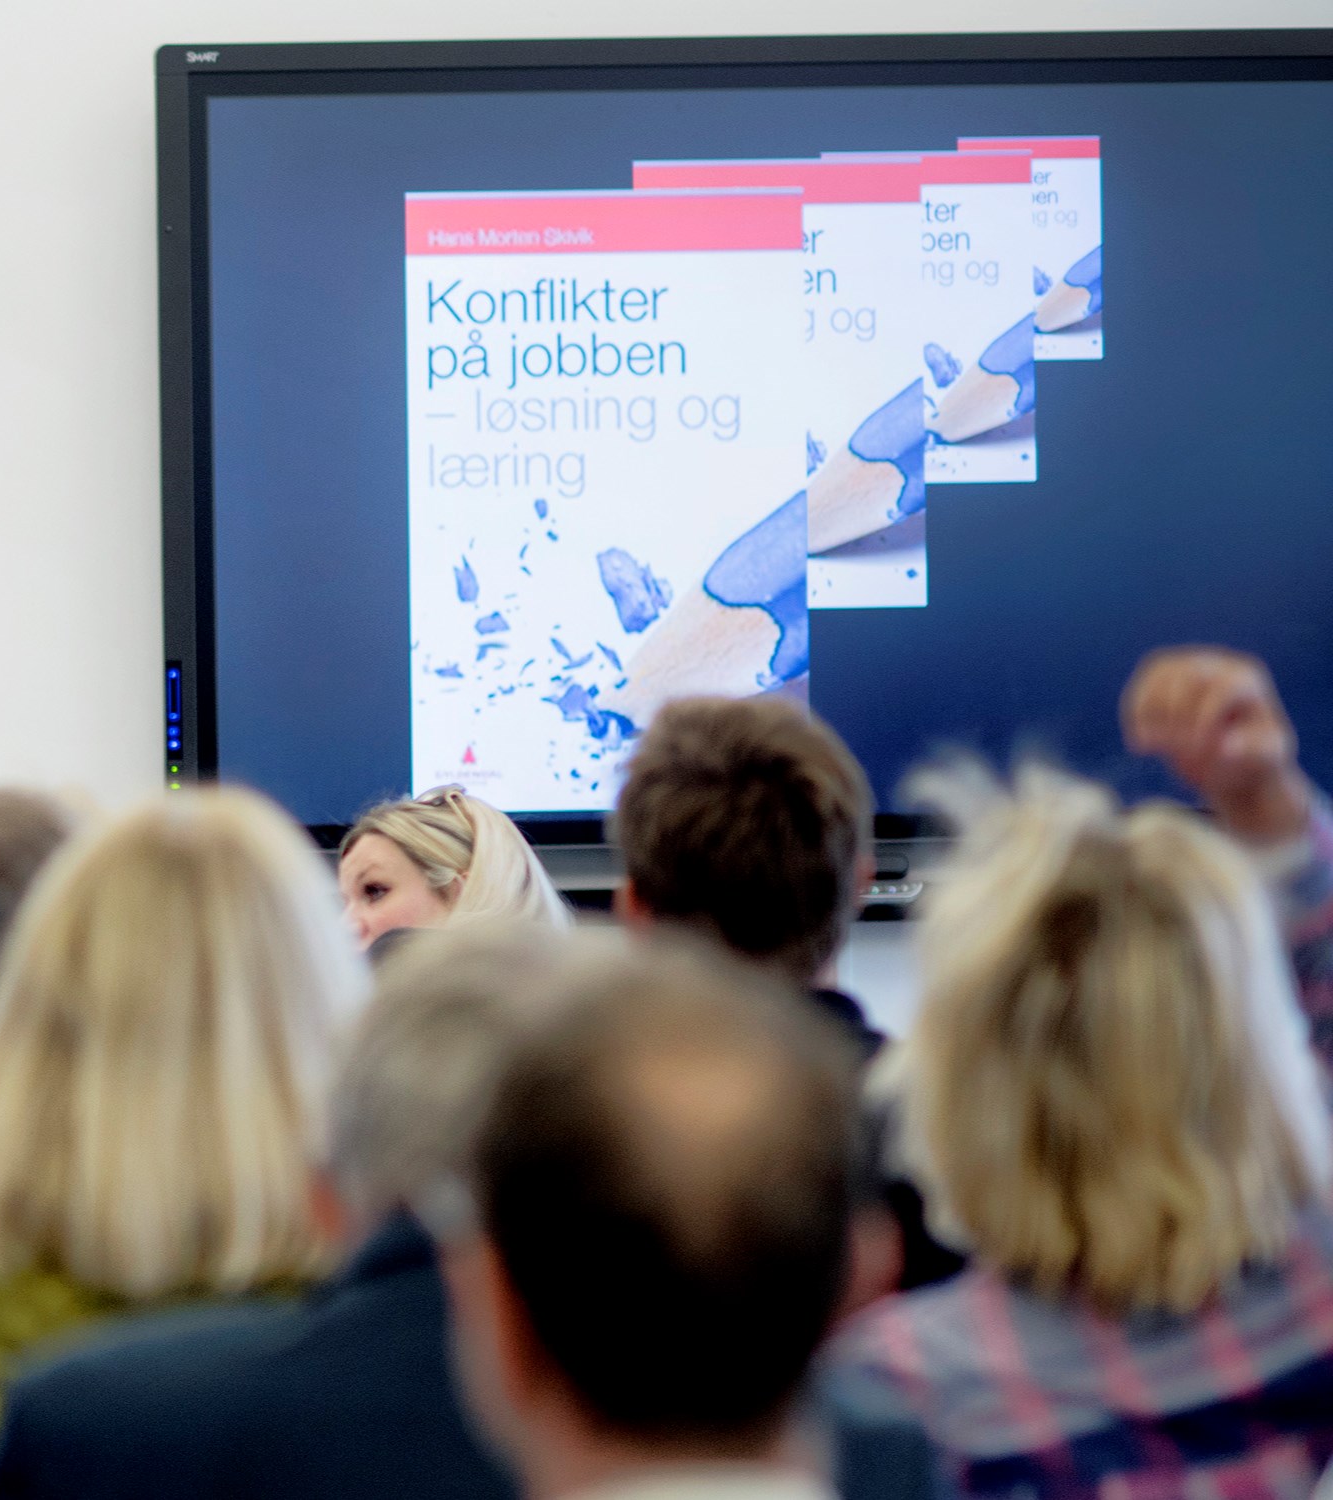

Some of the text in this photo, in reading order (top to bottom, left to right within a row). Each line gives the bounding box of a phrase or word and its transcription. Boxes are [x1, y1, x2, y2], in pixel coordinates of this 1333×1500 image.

[427, 229, 474, 246] Hans
[478, 228, 540, 246] Morten
[965, 260, 999, 287] og
[428, 278, 670, 324] Konflikter
[830, 307, 876, 343] og
[428, 329, 687, 390] på jobben
[476, 387, 657, 443] løsning
[678, 394, 741, 441] og
[429, 442, 586, 499] læring
